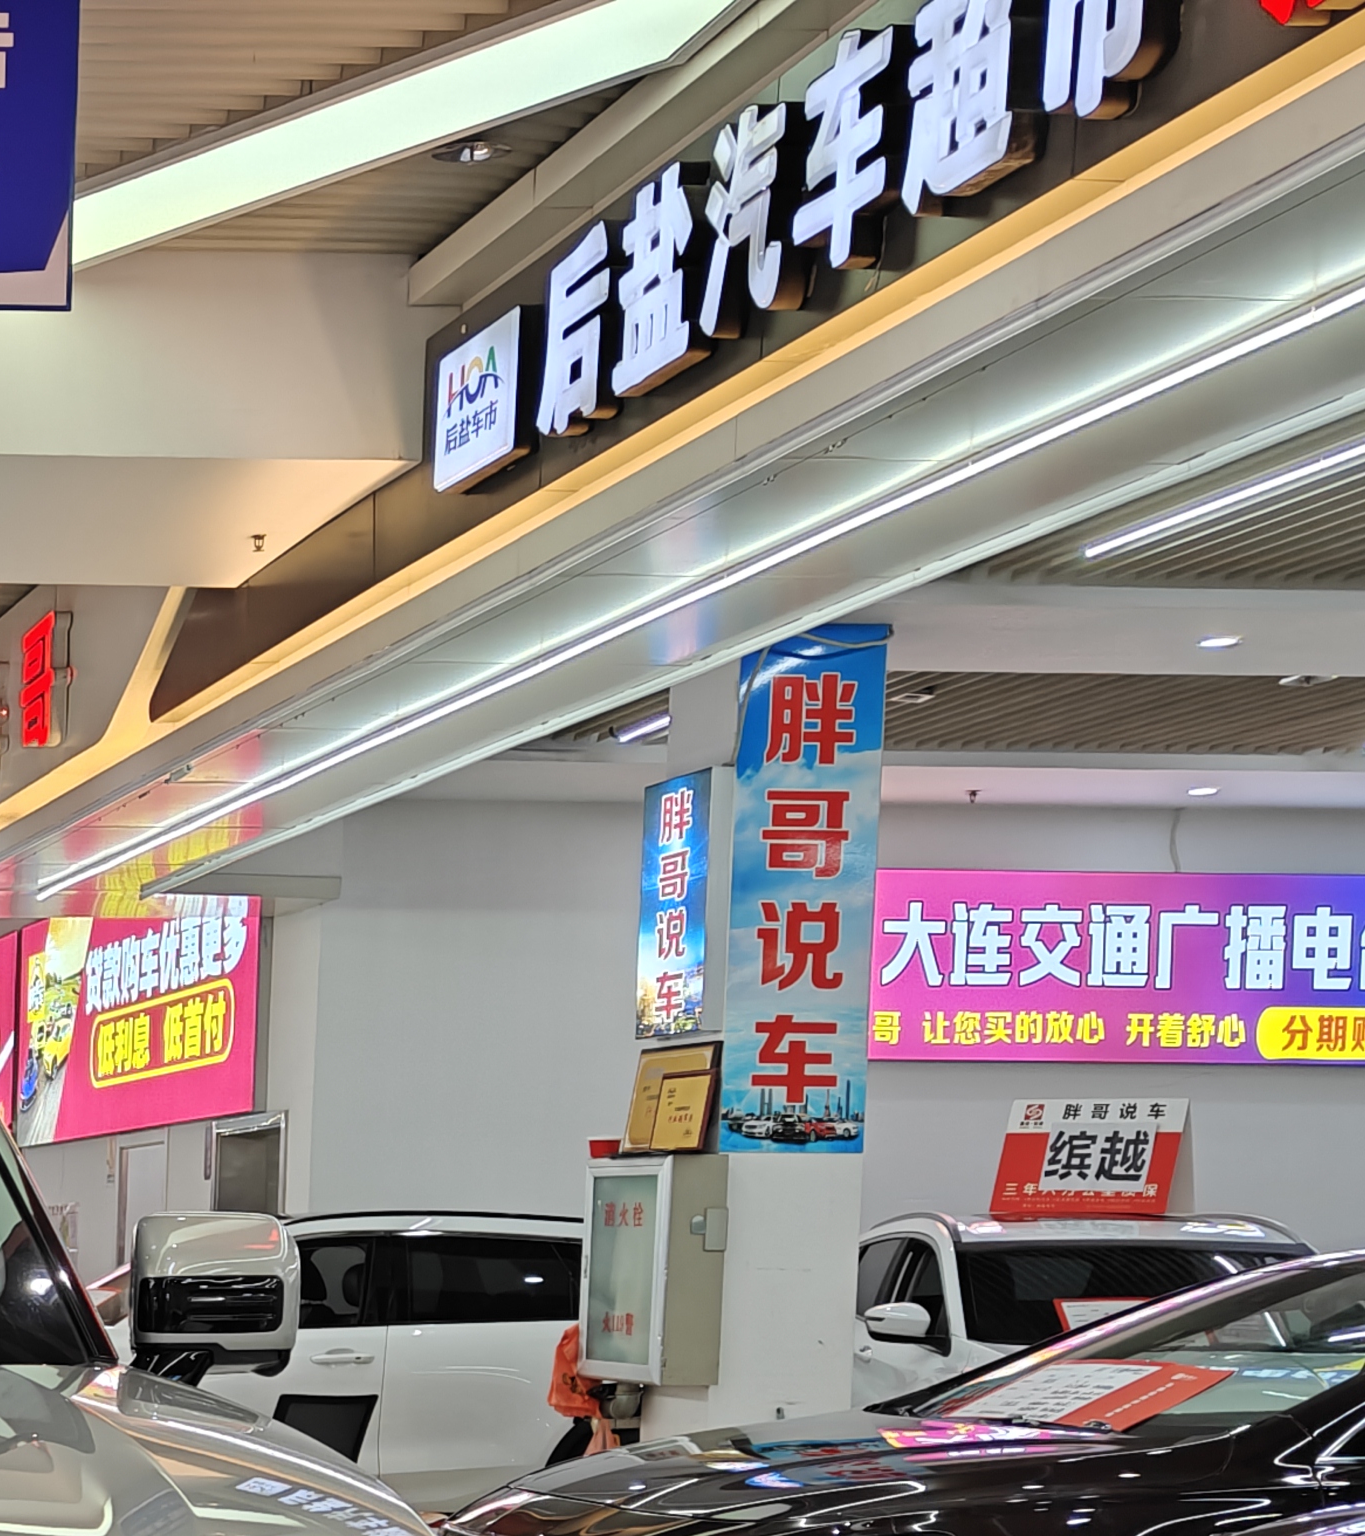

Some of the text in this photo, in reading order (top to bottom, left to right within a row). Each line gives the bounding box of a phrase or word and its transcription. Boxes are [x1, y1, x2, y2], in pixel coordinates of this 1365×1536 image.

[443, 399, 499, 457] 后盐车市
[654, 787, 694, 1023] 胖哥说车
[750, 672, 858, 1106] 胖哥说车
[880, 900, 1365, 993] 大连交通广播电
[97, 990, 227, 1078] 低利息 低首付
[922, 1010, 1106, 1047] 让您买的放心
[1125, 1011, 1247, 1049] 开着舒心
[1062, 1102, 1167, 1121] 胖哥说车
[1043, 1130, 1150, 1182] 缤越
